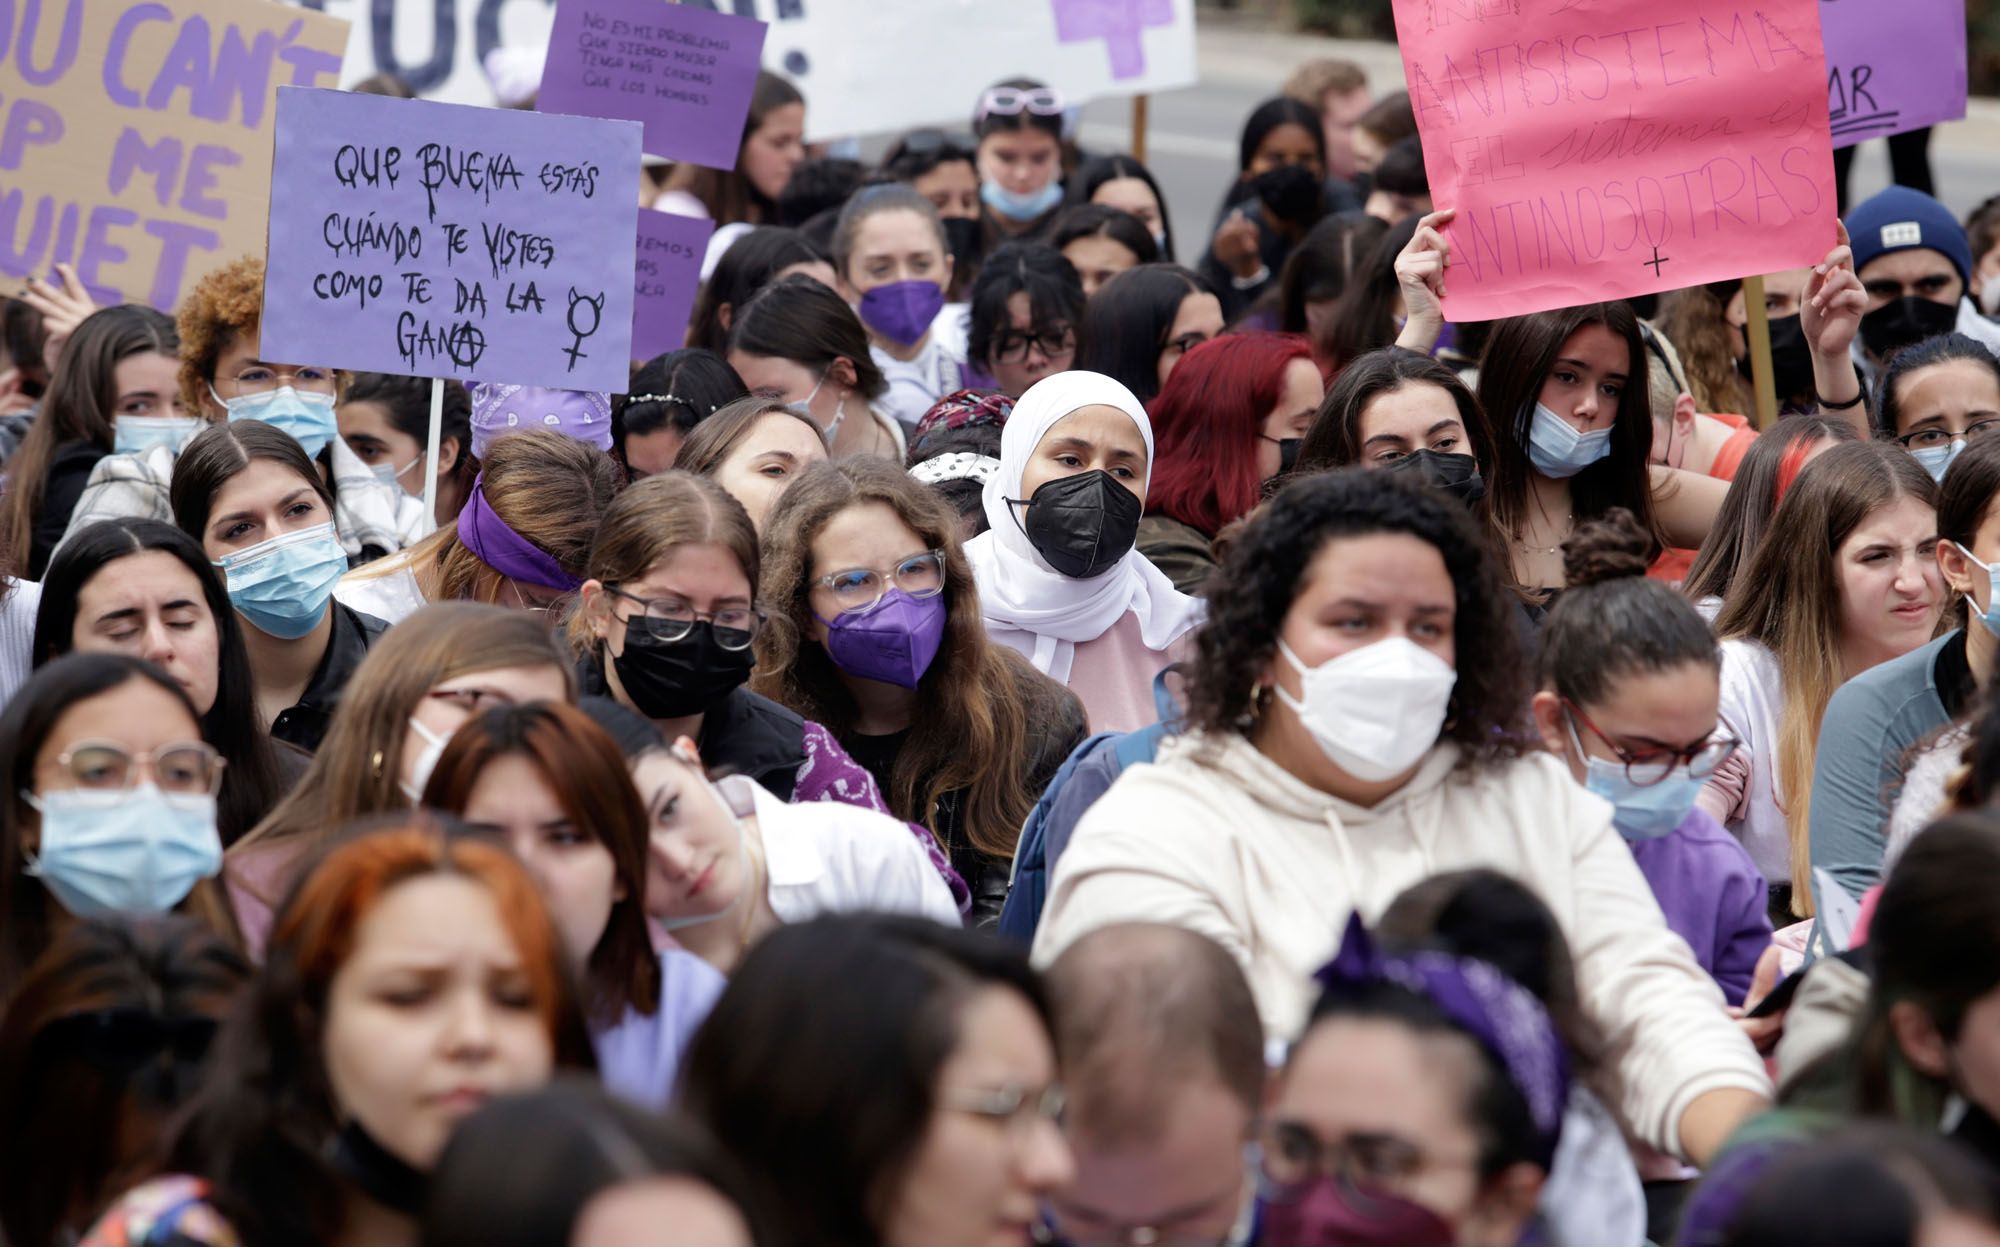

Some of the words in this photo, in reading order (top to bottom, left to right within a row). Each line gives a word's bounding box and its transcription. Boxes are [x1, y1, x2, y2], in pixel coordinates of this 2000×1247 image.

[0, 0, 84, 87] U
[579, 31, 610, 49] QUE
[617, 41, 669, 58] SIENDO
[674, 50, 718, 66] MUJER
[583, 11, 607, 30] NO
[611, 19, 631, 35] ES
[634, 26, 652, 40] MI
[657, 28, 731, 51] PROBLEMA
[583, 70, 612, 88] QUE
[619, 80, 646, 95] LOS
[1411, 9, 1813, 127] ANTISISTEMA
[108, 126, 242, 221] ME
[334, 145, 401, 190] QUE
[416, 143, 525, 216] BUENA
[538, 161, 599, 198] ESTÁS
[1448, 134, 1526, 187] EL
[1538, 104, 1744, 171] sistema
[0, 187, 223, 315] UIET
[324, 212, 422, 265] CUÁNDO
[442, 223, 469, 266] TE
[482, 222, 555, 278] VISTES
[313, 271, 383, 309] COMO
[401, 272, 432, 303] TE
[455, 278, 487, 318] DA
[506, 281, 546, 314] LA
[397, 311, 488, 373] GANA
